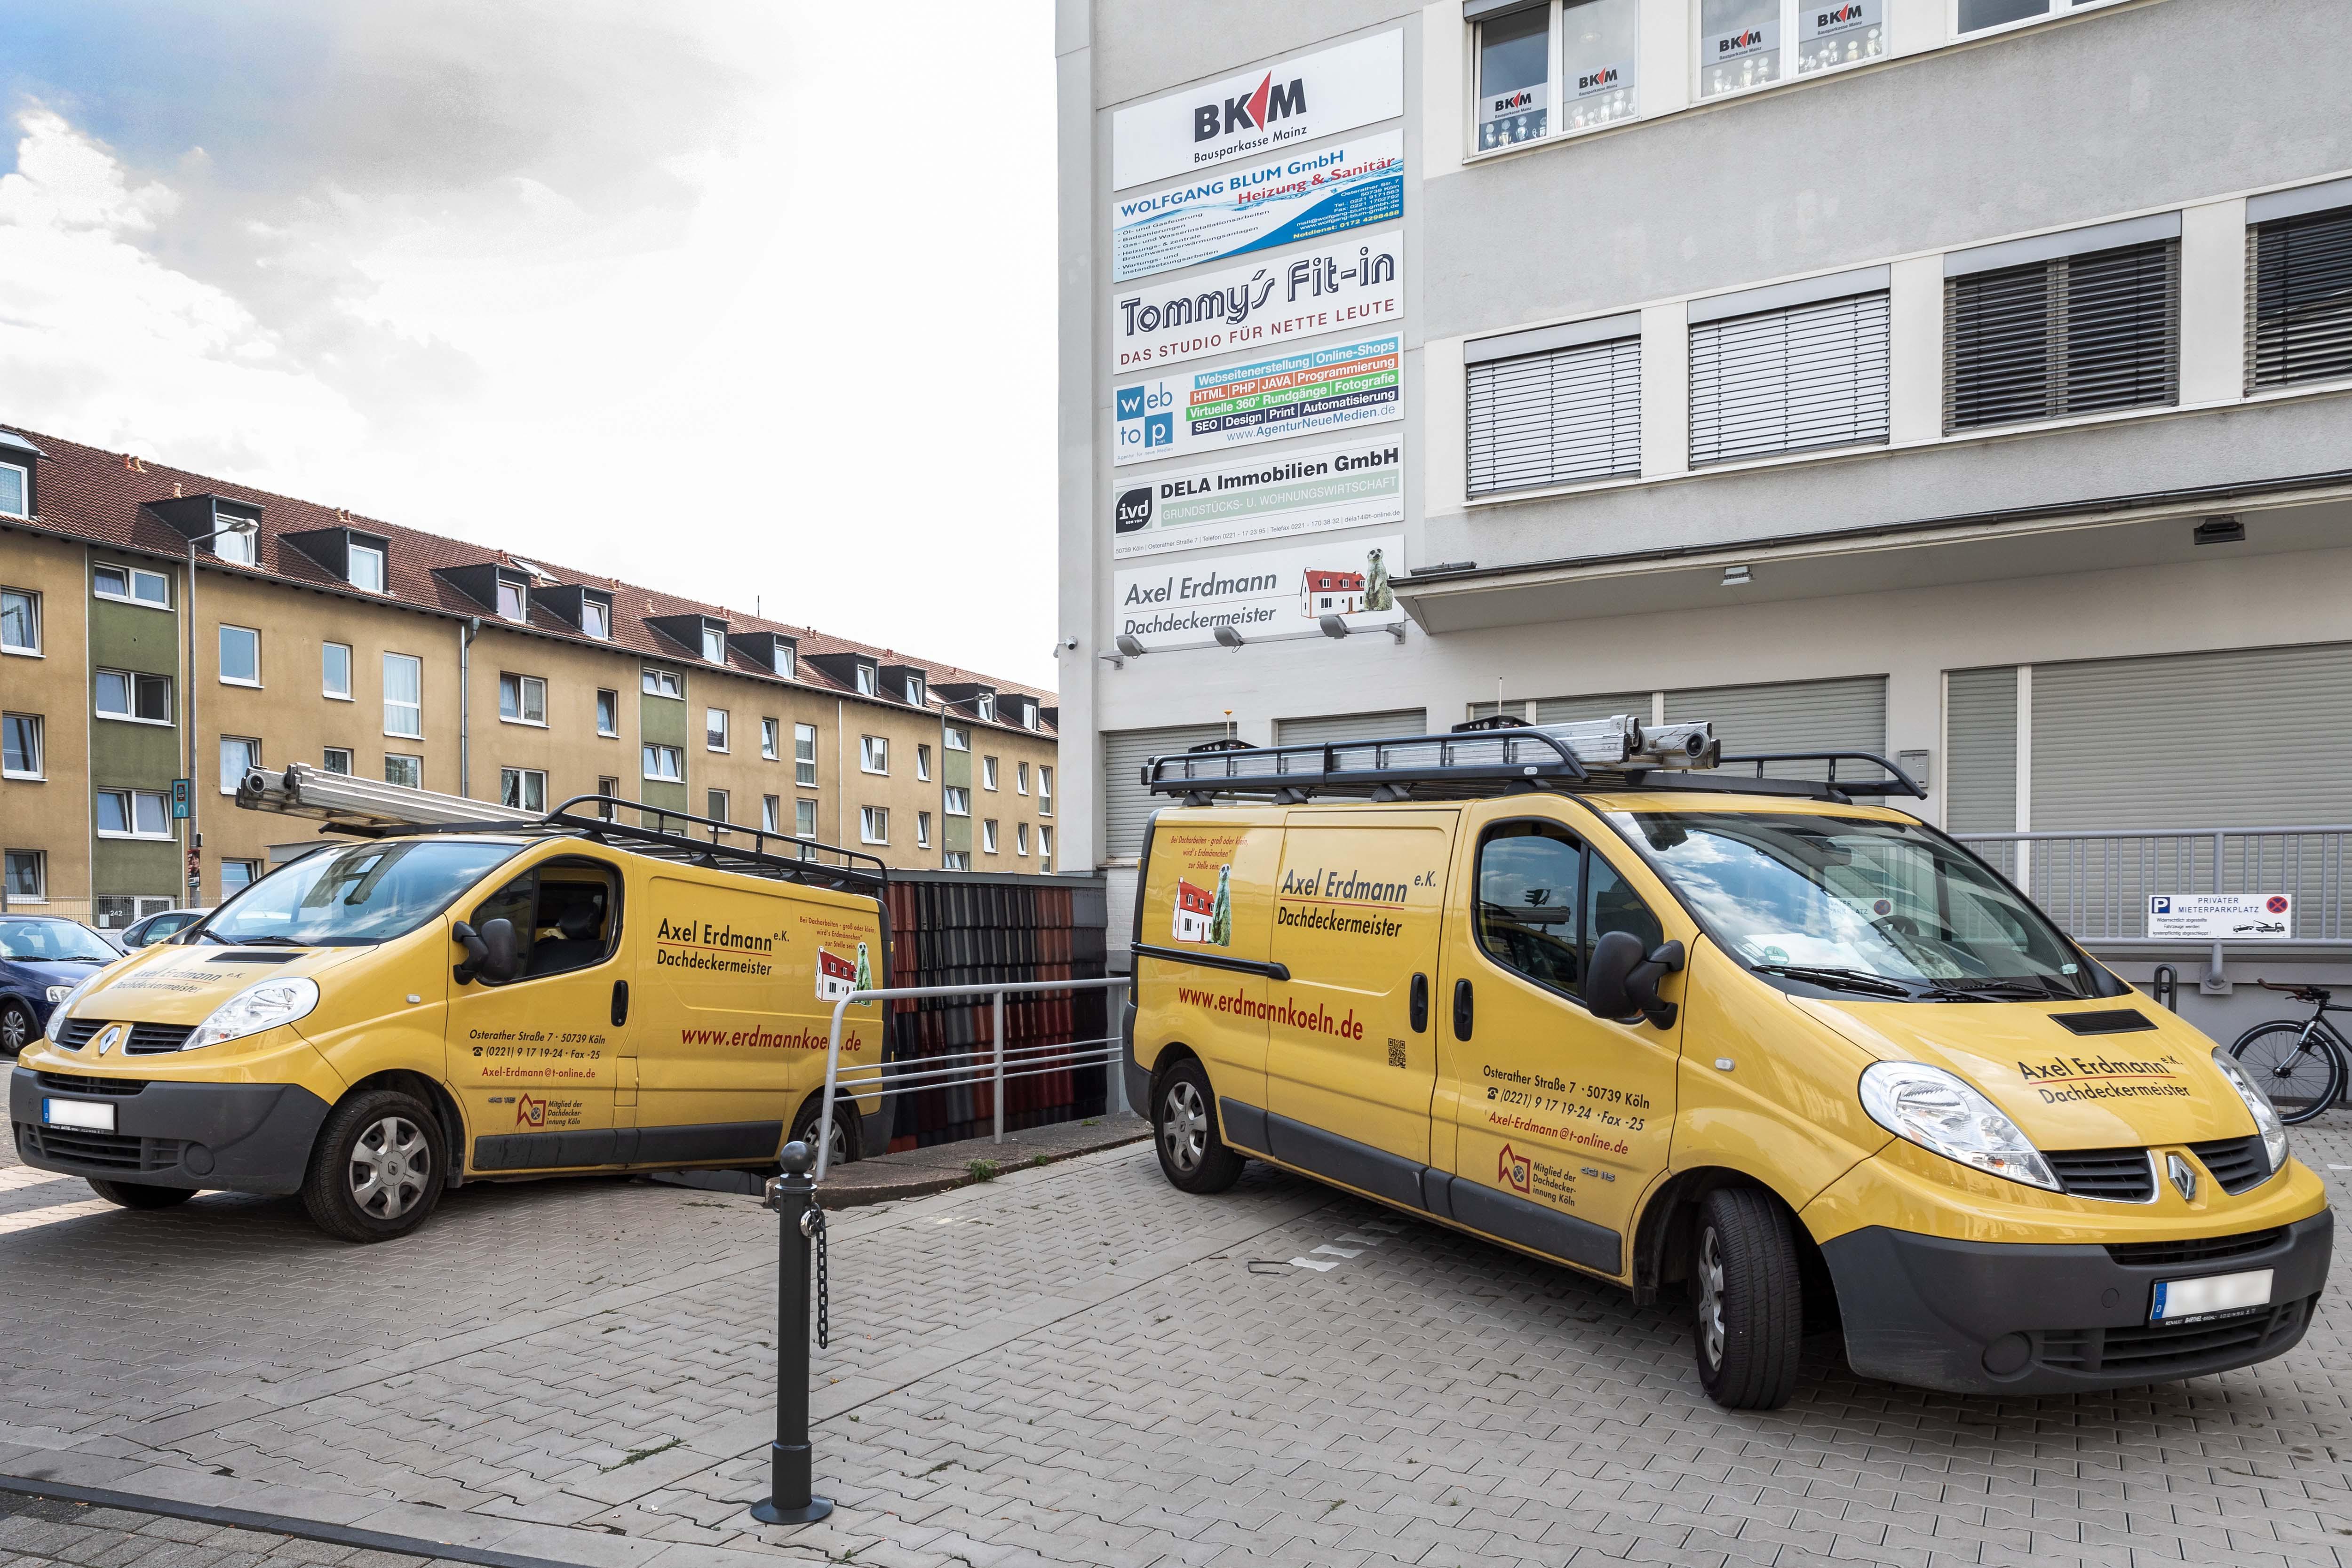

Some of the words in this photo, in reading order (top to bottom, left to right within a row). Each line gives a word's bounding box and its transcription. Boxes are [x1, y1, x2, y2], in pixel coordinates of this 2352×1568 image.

[1818, 5, 1862, 27] BKM
[1719, 31, 1761, 52] BKM
[1818, 24, 1848, 35] Bausparkasse
[1719, 49, 1748, 60] Bausparkasse
[1579, 69, 1618, 88] BKM
[1194, 78, 1307, 143] BKM
[1495, 93, 1531, 111] BKM
[1194, 137, 1268, 163] Bausparkasse
[1273, 126, 1307, 142] Mainz
[1121, 182, 1224, 217] WOLFGANG
[1230, 167, 1281, 190] BLUM
[1287, 150, 1343, 175] GmbH
[1238, 180, 1306, 204] Heizung
[1311, 174, 1324, 186] &
[1331, 158, 1394, 181] Sanitär
[1341, 185, 1378, 197] Osterather
[1370, 194, 1399, 204] 1702792
[1153, 213, 1203, 228] Gasfeuerung
[1159, 210, 1269, 240] Wasserinstallationsarbeiten
[1297, 199, 1399, 226] mail@wolfgang-blum-gmbh.de
[1300, 204, 1399, 230] www.wolfgang-blum-gmbh.de
[1122, 226, 1258, 261] Brauchwassererwärmungsanlagen
[1123, 224, 1185, 242] Badsanierungen
[1123, 245, 1160, 255] Heizungs-
[1170, 234, 1201, 244] zentrale
[1294, 225, 1337, 239] Notdienst:
[1123, 256, 1162, 269] Wartungs-
[1123, 250, 1218, 275] Instandsetzungsarbeiten
[1121, 269, 1275, 336] Tommy's
[1288, 247, 1394, 302] Fit-in
[1121, 349, 1152, 365] DAS
[1160, 335, 1221, 358] STUDIO
[1230, 324, 1262, 343] FÜR
[1271, 313, 1327, 334] NETTE
[1336, 299, 1394, 320] LEUTE
[1199, 357, 1309, 386] Webseitenerstellung
[1316, 341, 1395, 364] Online-Shops
[1193, 388, 1225, 402] HTML
[1232, 382, 1255, 395] PHP
[1262, 376, 1291, 390] JAVA
[1297, 357, 1395, 383] Programmierung
[1190, 402, 1233, 418] Virtuelle
[1236, 397, 1260, 409] 360°
[1263, 385, 1327, 405] Rundgänge
[1335, 374, 1395, 394] Fotografie
[1195, 420, 1218, 432] SEO
[1226, 413, 1262, 427] Design
[1270, 406, 1295, 419] Print
[1303, 389, 1395, 413] Automatisierung
[1227, 404, 1395, 441] www.AgenturNeueMedien.de
[1161, 476, 1211, 499] DELA
[1218, 461, 1327, 490] Immobilien
[1335, 447, 1398, 471] GmbH
[1120, 500, 1148, 519] ivd
[1163, 497, 1242, 520] GRUNDSTÜCKS-
[1260, 476, 1396, 506] WOHNUNGSWIRTSCHAFT
[1344, 510, 1400, 522] dela14@t-online.de
[1125, 577, 1171, 606] Axel
[1180, 572, 1277, 597] Erdmann
[1125, 607, 1276, 635] Dachdeckermeister
[1178, 836, 1207, 844] Dacharbeiten
[1210, 836, 1222, 846] groß
[1223, 836, 1234, 845] oder
[1197, 861, 1208, 869] Stelle
[1281, 868, 1322, 896] Axel
[1325, 870, 1407, 902] Erdmann
[1414, 870, 1437, 887] e.K.
[657, 918, 697, 942] Axel
[704, 924, 772, 951] Erdmann
[774, 931, 789, 942] e.K.
[809, 917, 838, 928] Dacharbeiten
[1278, 907, 1402, 937] Dachdeckermeister
[657, 949, 771, 975] Dachdeckermeister
[1179, 987, 1363, 1041] www.erdmannkoeln.de
[470, 1030, 516, 1041] Osterather
[518, 1031, 545, 1041] Straße
[561, 1034, 587, 1043] 50739
[588, 1035, 605, 1044] Köln
[682, 1025, 861, 1051] www.erdmannkoe.de
[486, 1046, 514, 1058] (0221)
[527, 1048, 537, 1057] 17
[540, 1048, 563, 1058] 19-24
[571, 1050, 584, 1059] Fax
[587, 1051, 599, 1059] -25
[482, 1067, 596, 1078] Axel-Erdmann@t-online.de
[2018, 1057, 2074, 1080] Axel
[2071, 1055, 2170, 1075] Erdmann
[2160, 1055, 2183, 1065] e.K.
[1484, 1065, 1531, 1085] Osterather
[1535, 1075, 1565, 1092] Straße
[1569, 1082, 1576, 1093] 7
[1586, 1085, 1621, 1103] 50739
[1626, 1092, 1649, 1109] Köln
[2038, 1081, 2190, 1104] Dachdeckermeister
[1501, 1088, 1532, 1108] (0221)
[1535, 1097, 1542, 1108] 9
[1545, 1099, 1558, 1111] 17
[1561, 1102, 1591, 1119] 19-24
[1602, 1111, 1620, 1126] Fax
[1626, 1118, 1644, 1131] -25
[1489, 1111, 1629, 1154] Axel-Erdmann@t-online.de
[1533, 1162, 1562, 1179] Mitglied
[1563, 1170, 1576, 1182] der
[1533, 1175, 1576, 1194] Dachdecker-
[1533, 1186, 1557, 1202] innung
[1559, 1194, 1574, 1206] Köln
